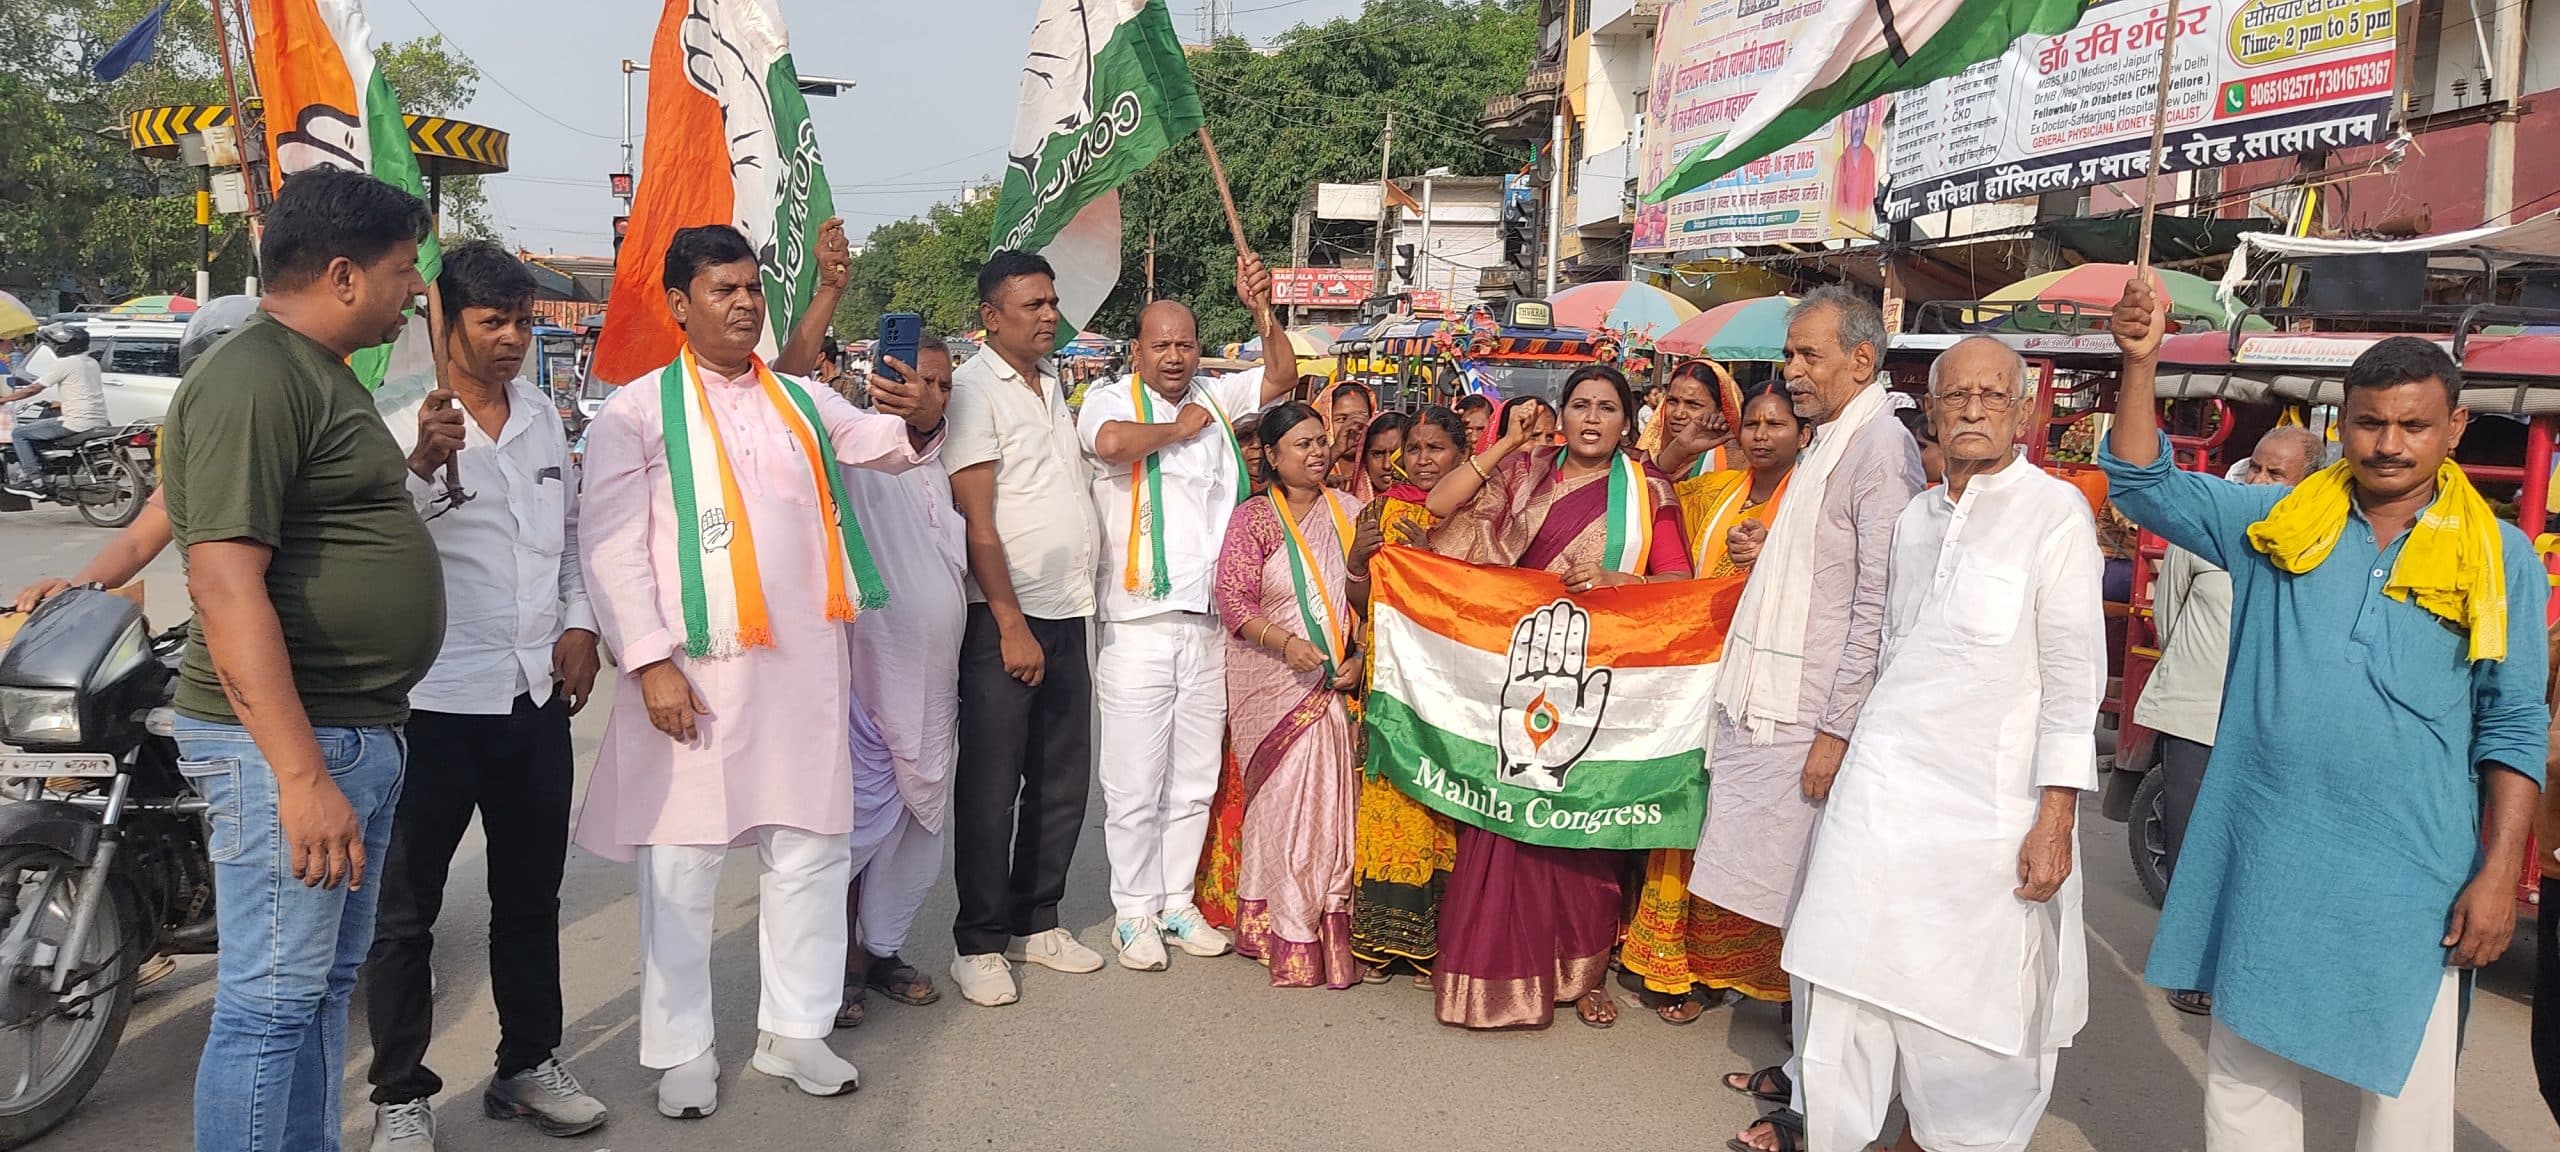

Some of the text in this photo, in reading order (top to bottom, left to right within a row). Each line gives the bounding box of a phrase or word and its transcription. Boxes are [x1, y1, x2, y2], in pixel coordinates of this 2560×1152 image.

[2245, 0, 2303, 28] सोमवार
[2075, 23, 2122, 63] रवि
[2127, 8, 2211, 50] शंकर
[2285, 27, 2295, 46] 2
[2299, 25, 2322, 49] pm
[2328, 16, 2344, 37] to
[2350, 12, 2360, 33] 5
[2365, 10, 2391, 37] pm
[2078, 59, 2121, 80] (Medicine)
[2123, 53, 2151, 69] Jaipur
[2184, 54, 2209, 71] Delhi
[2031, 124, 2040, 135] Ex
[2042, 109, 2116, 133] Doctor-Safdarjung
[2118, 98, 2157, 116] Hospital
[2183, 88, 2208, 105] Delhi
[2033, 102, 2077, 120] Fellowship
[2092, 89, 2133, 106] Diabetes
[2168, 75, 2203, 90] Vellore
[1952, 107, 1971, 122] CKD
[2032, 131, 2065, 148] GENERAL
[2116, 115, 2147, 132] KIDNEY
[2149, 105, 2201, 126] SCIALIST
[1797, 150, 1815, 170] 2025
[614, 175, 630, 193] 54
[1274, 273, 1374, 281] BARALA ENTERPRISES
[1412, 756, 1662, 834] Mahila Congress
